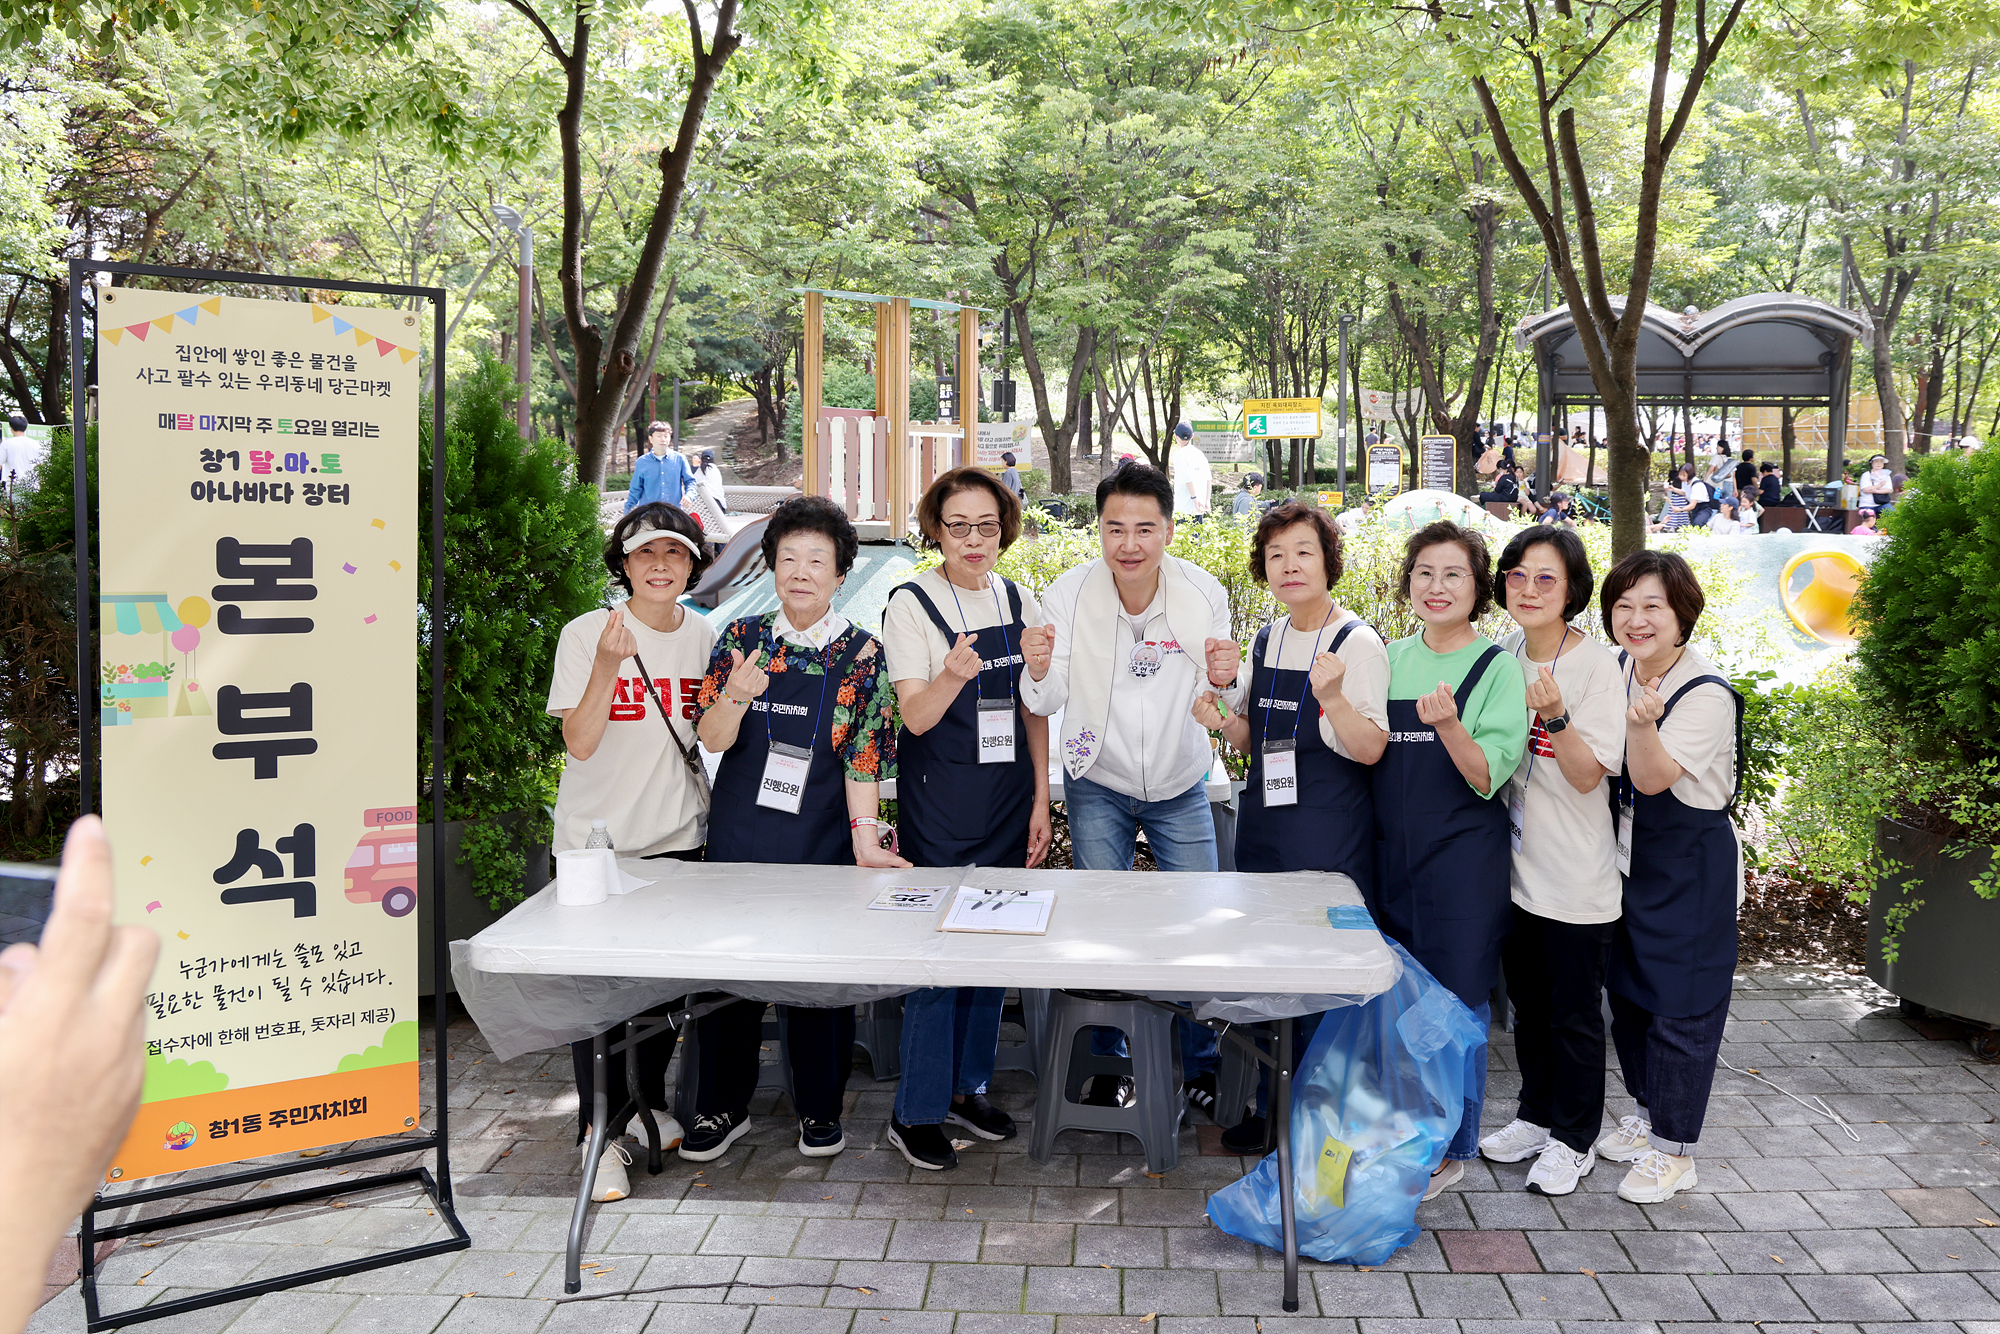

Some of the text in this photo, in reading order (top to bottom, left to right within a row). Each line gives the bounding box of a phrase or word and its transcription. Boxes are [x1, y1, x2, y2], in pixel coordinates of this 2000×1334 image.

[175, 345, 358, 372] 집안에 쌓인 좋은 물건을
[136, 367, 391, 398] 사고 팔수 있는 우리동네 당근마켓
[159, 413, 380, 438] 매달 마지막 주 토요일 열리는
[200, 448, 343, 474] 창1 달.마.토
[190, 480, 350, 506] 아나바다 장터
[771, 702, 808, 716] 주민자치회
[212, 536, 318, 918] 본부석
[1403, 731, 1434, 742] 주민자치회
[982, 735, 1012, 748] 진행요원
[763, 778, 800, 796] 진행요원
[1266, 776, 1294, 790] 진행요원
[376, 810, 413, 823] FOOD
[179, 940, 363, 980] 누군가에게는 쓸모 있고
[144, 969, 393, 1020] 필요한 물건이 될 수 있습니다.
[146, 1007, 396, 1056] 접수자에 한해 번호표, 돗자리 제공)
[208, 1096, 368, 1139] 창1동 주민자치회
